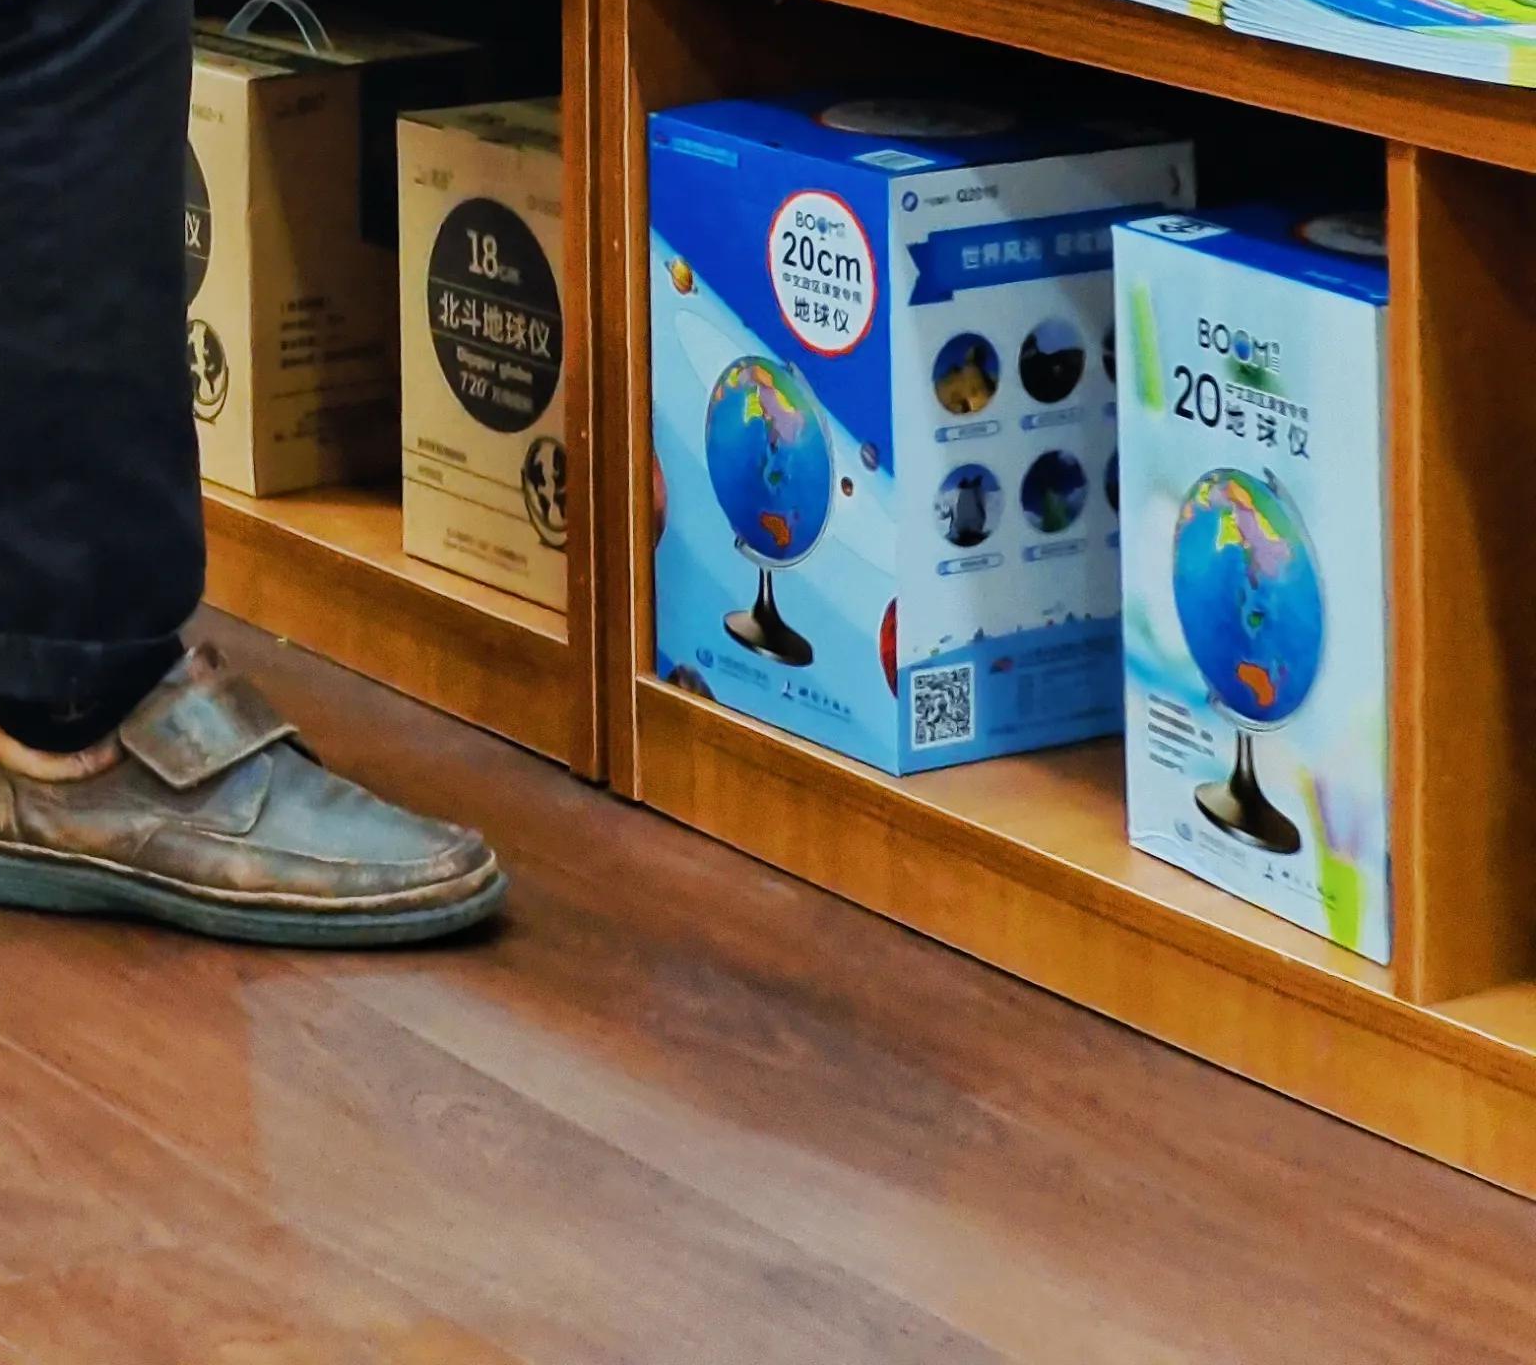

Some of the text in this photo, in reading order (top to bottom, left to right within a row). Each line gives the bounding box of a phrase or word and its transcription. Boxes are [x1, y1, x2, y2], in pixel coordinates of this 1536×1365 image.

[782, 230, 862, 285] 20cm
[438, 289, 552, 359] 北斗地球仪
[793, 294, 851, 335] 地球仪
[1174, 365, 1222, 429] 20
